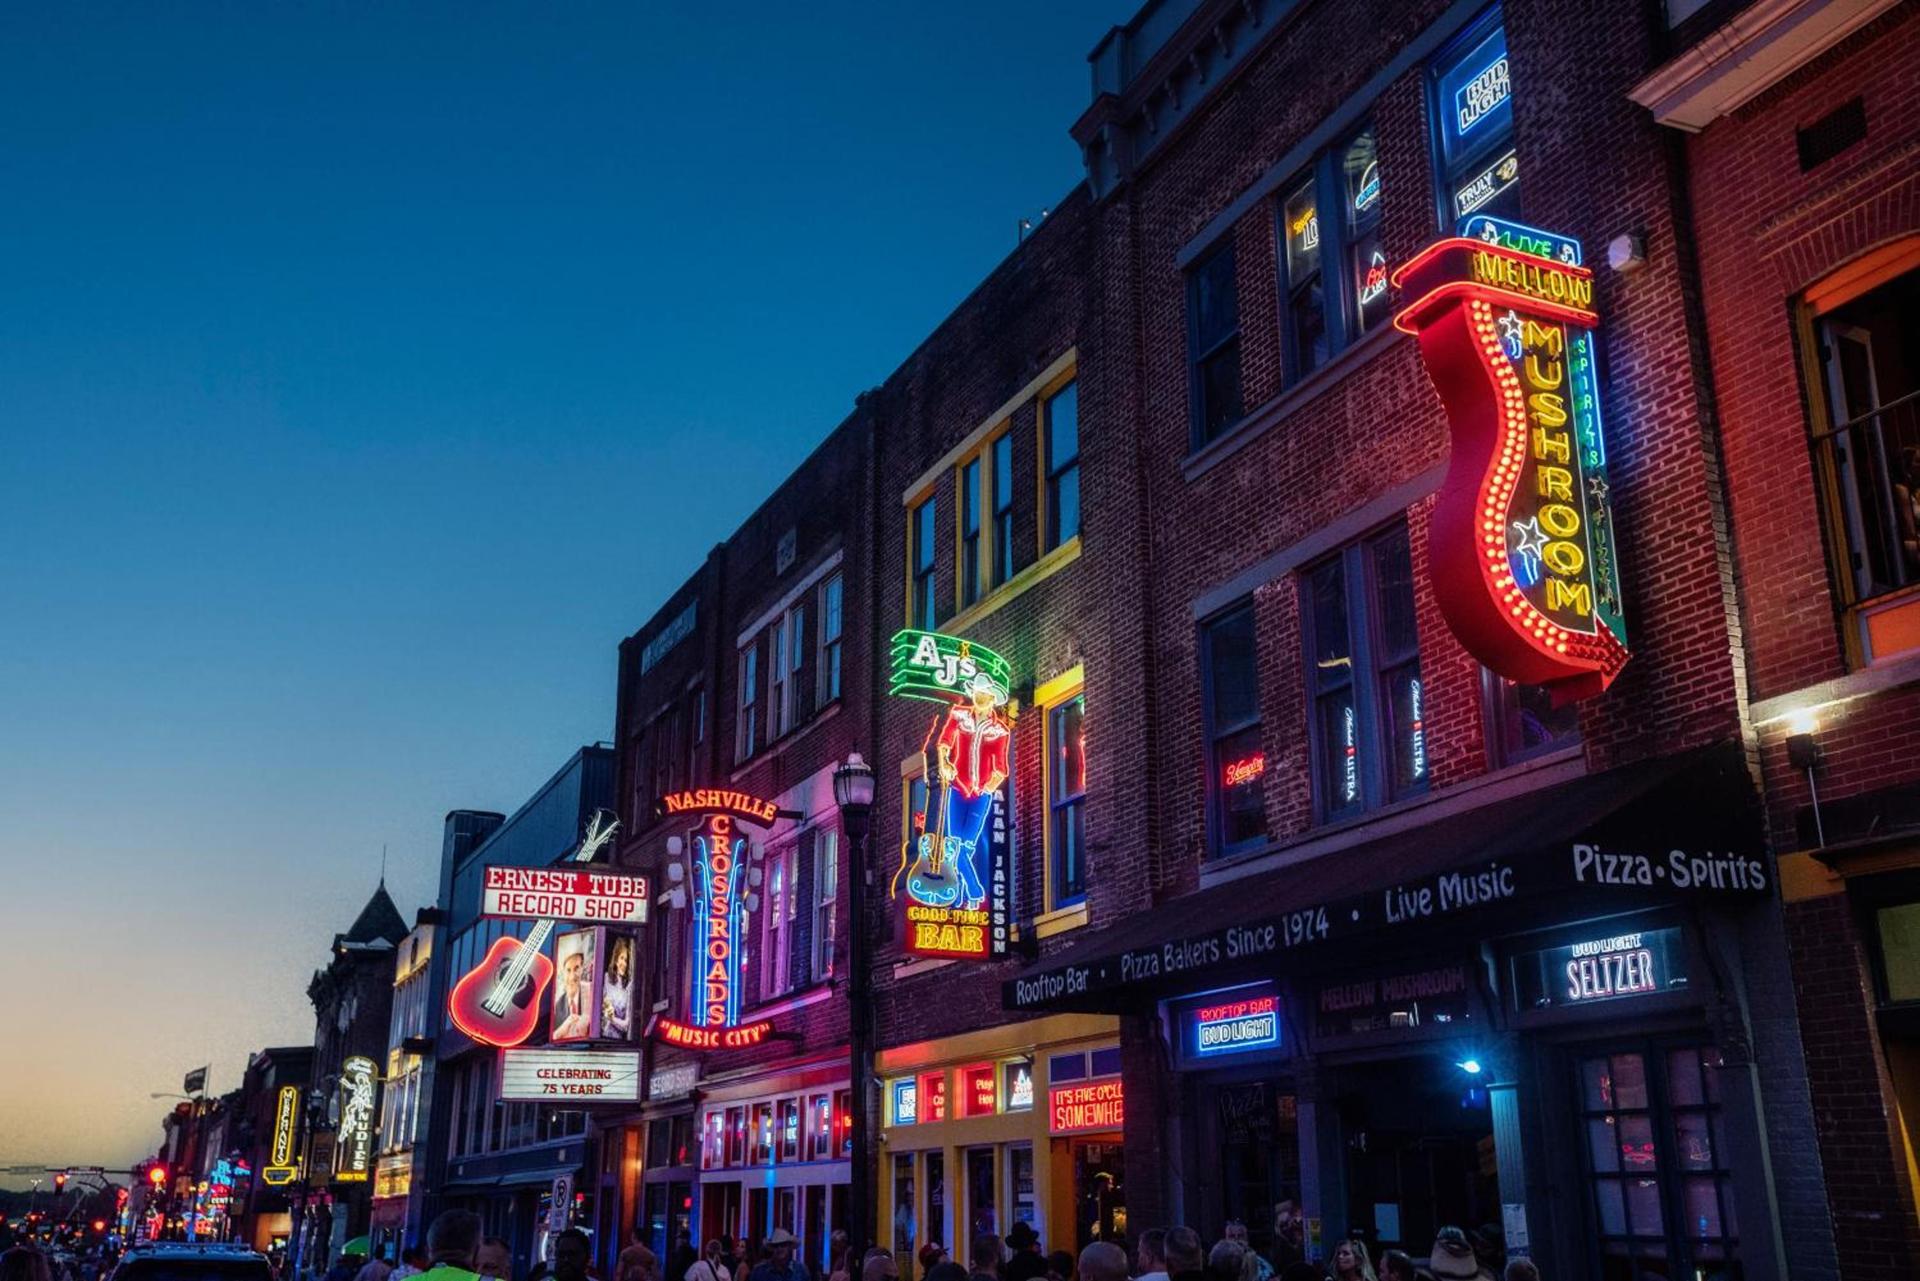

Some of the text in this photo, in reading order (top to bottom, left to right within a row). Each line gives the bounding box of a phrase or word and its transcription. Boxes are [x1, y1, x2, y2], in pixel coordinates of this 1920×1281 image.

[1466, 59, 1508, 104] BUD
[1458, 172, 1492, 207] TRULY
[1497, 231, 1552, 259] LIVE
[1474, 251, 1591, 308] MELLOW
[1577, 339, 1598, 466] SPIRITS
[1522, 319, 1591, 617] MUSHROOM
[1413, 731, 1424, 777] ULTRA
[1347, 756, 1356, 801] ULTRA
[664, 789, 778, 822] NASHVILLE
[487, 867, 646, 898] ERNEST TUBB
[992, 790, 1006, 954] ALAN JACKSON
[1572, 843, 1767, 891] Pizza Spirits
[498, 892, 635, 919] RECORD SHOP
[708, 815, 732, 1026] CROSSROADS
[907, 906, 990, 926] GOOD-TIME
[915, 922, 984, 952] BAR
[1015, 862, 1515, 1005] Rooftop Bar Pizza Bakers Since 1974 Live Music
[1600, 932, 1642, 953] LIGHT
[1320, 966, 1466, 1013] MELLOW MUSHROOM
[1566, 948, 1656, 1001] SELTZER
[1201, 998, 1273, 1022] ROOFTOP BAR
[1202, 1018, 1271, 1046] BUD LIGHT
[536, 1068, 612, 1081] CELEBRATING
[542, 1083, 604, 1096] 75 YEARS
[1056, 1089, 1073, 1106] IT'S
[1075, 1086, 1096, 1104] FIVE
[1056, 1100, 1124, 1131] SOMEWHE
[277, 1090, 293, 1163] MERCHANTS
[352, 1110, 370, 1171] NUDIES
